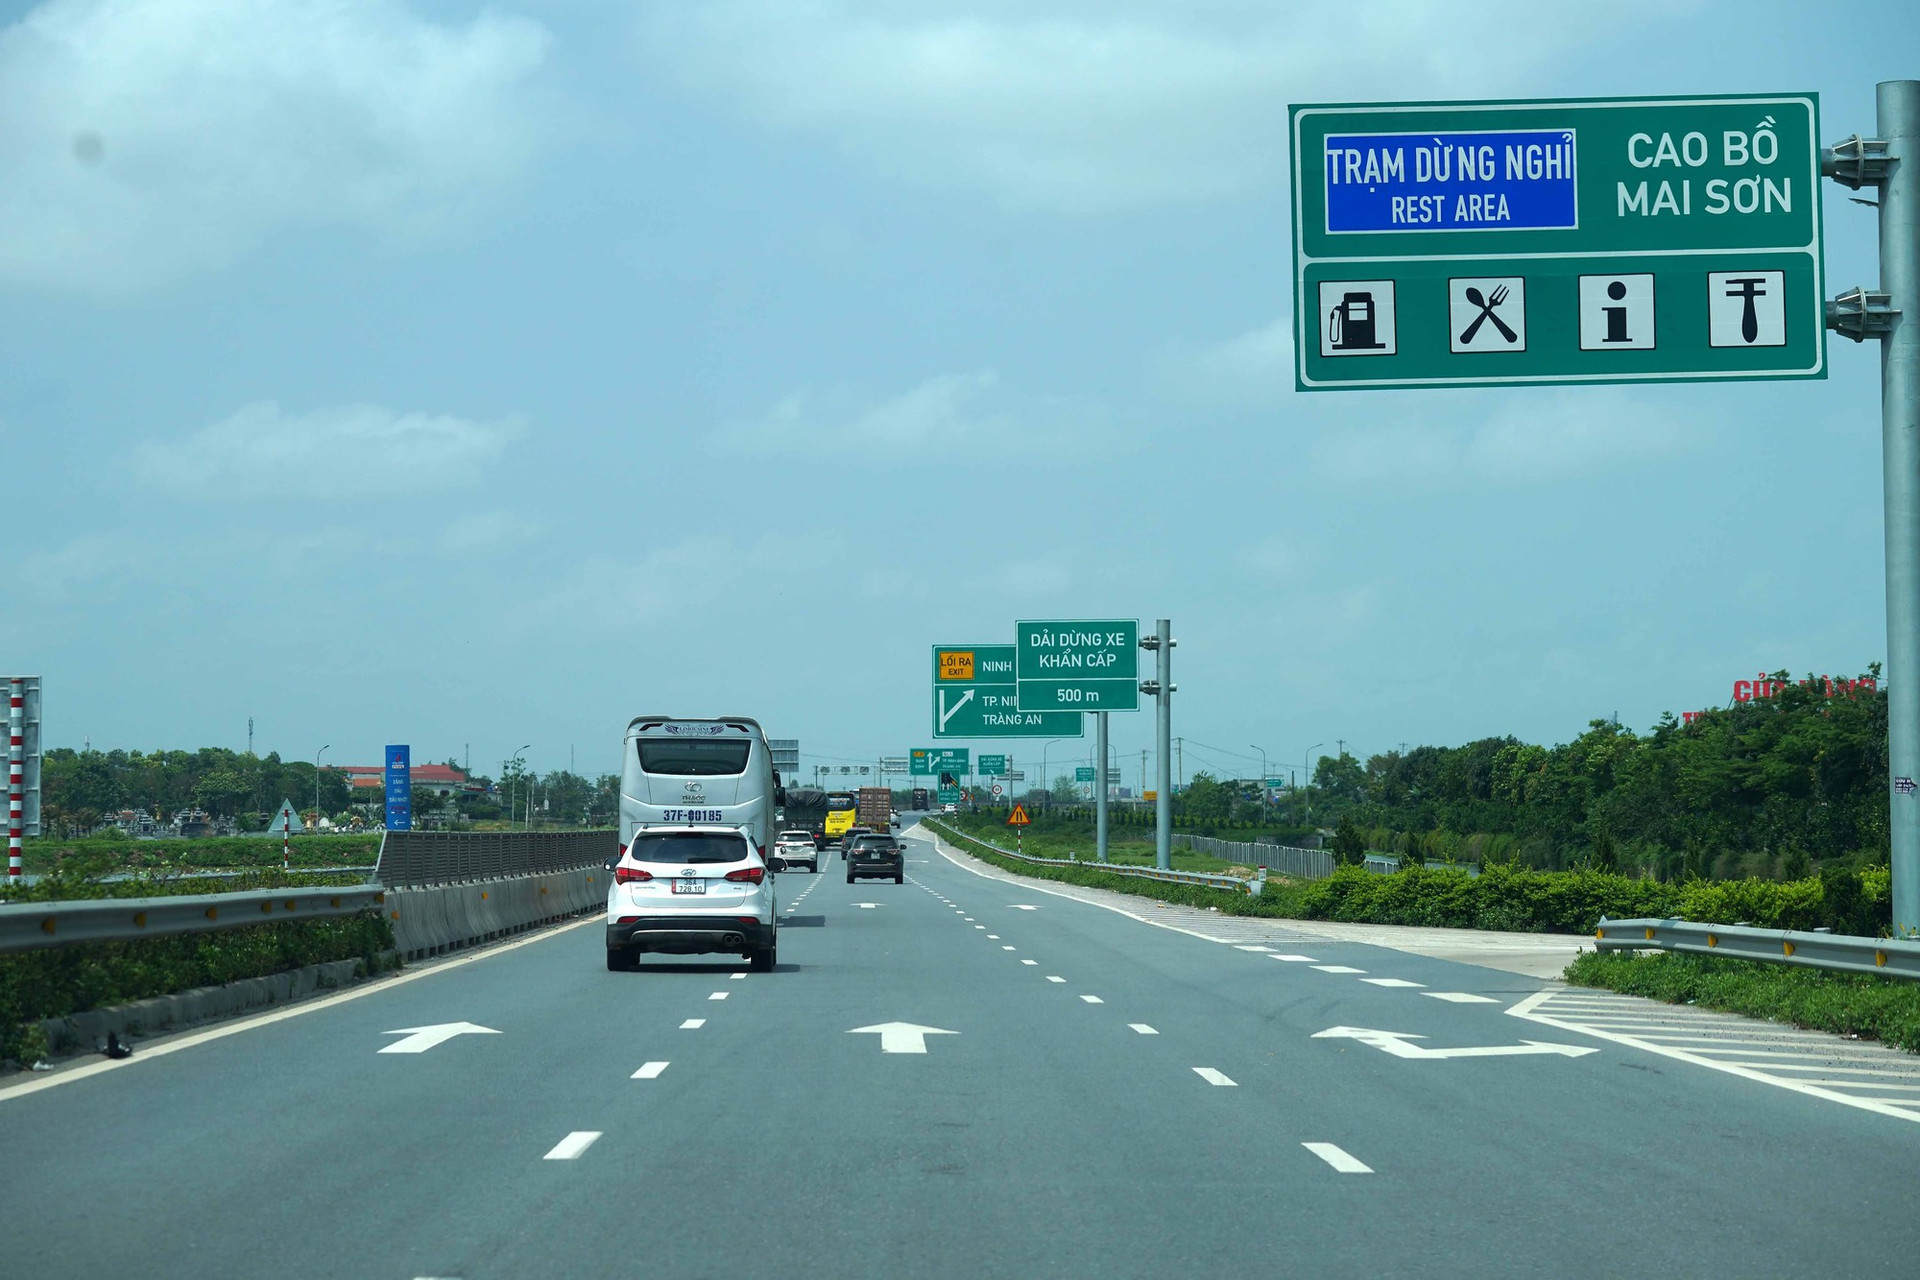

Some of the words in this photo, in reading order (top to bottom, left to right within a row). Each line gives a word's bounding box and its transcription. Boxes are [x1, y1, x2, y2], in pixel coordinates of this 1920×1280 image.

[1627, 131, 1709, 169] CAO
[1722, 115, 1780, 167] BỒ
[1328, 145, 1405, 193] TRẠM
[1415, 137, 1495, 182] DỪNG
[1505, 132, 1573, 181] NGHỈ
[1616, 179, 1691, 217] MAI
[1704, 174, 1793, 215] SƠN
[1391, 195, 1445, 224] REST
[1454, 193, 1511, 222] AREA
[1030, 629, 1055, 647] DẢI
[1059, 630, 1102, 646] DỪNG
[1106, 633, 1125, 646] XE
[940, 654, 957, 667] LỐI
[958, 657, 971, 667] RA
[982, 661, 1012, 672] NINH
[1039, 649, 1082, 668] KHẨN
[1086, 649, 1117, 667] CẤP
[948, 667, 964, 676] EXIT
[982, 696, 998, 707] TP.
[1057, 688, 1082, 702] 500
[1086, 691, 1100, 702] m
[983, 711, 1022, 726] TRÀNG
[1025, 714, 1042, 725] AN
